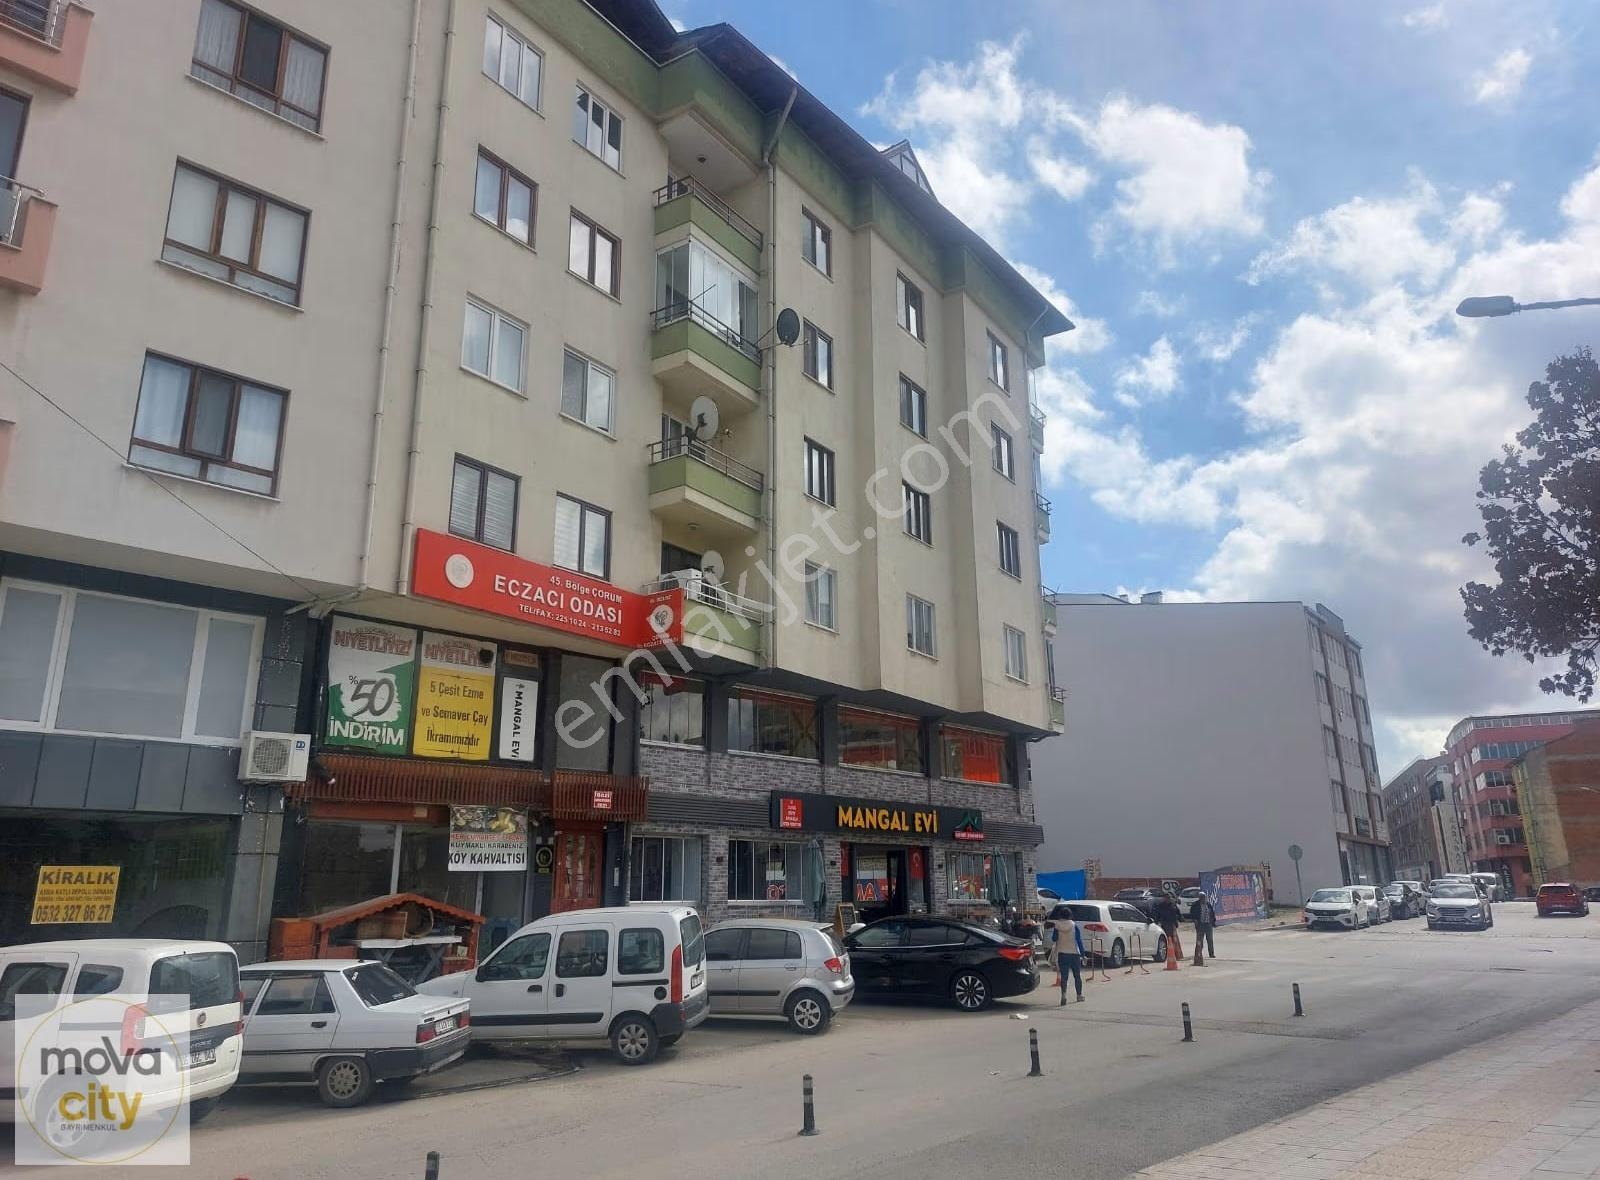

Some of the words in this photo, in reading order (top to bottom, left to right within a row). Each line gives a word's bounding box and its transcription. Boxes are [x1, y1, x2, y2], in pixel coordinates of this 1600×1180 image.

[493, 574, 564, 609] ECZACI
[569, 596, 622, 625] ODASI
[591, 587, 622, 604] ÇORUM
[430, 681, 436, 693] 5
[462, 685, 484, 700] Ezme
[421, 706, 431, 717] ve
[433, 705, 471, 722] Semaver
[472, 711, 489, 726] Çay
[511, 690, 523, 738] MANGAL
[329, 715, 405, 746] İNDİRİM
[838, 805, 909, 831] MANGAL
[914, 809, 938, 834] EVİ
[469, 852, 525, 865] KAHVALTISI
[41, 868, 116, 885] KİRALIK
[35, 904, 60, 922] 0532
[62, 904, 82, 922] 327
[98, 904, 112, 921] 27
